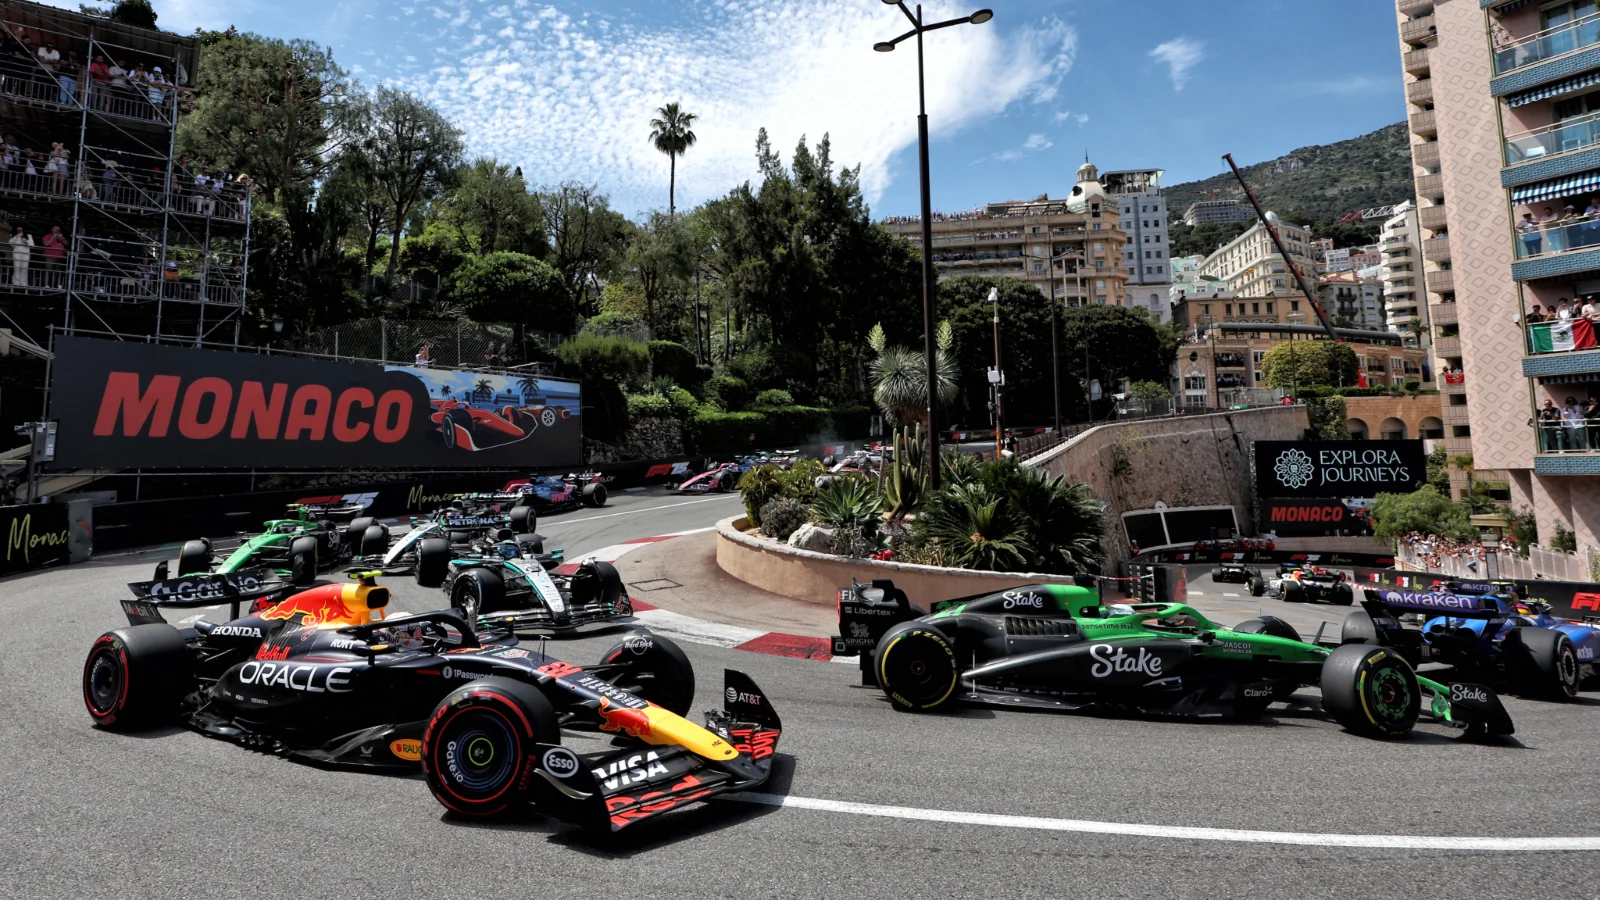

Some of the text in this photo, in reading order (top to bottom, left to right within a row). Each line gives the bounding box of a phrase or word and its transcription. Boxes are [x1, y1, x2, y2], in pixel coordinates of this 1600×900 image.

[94, 371, 413, 443] MONACO
[1319, 450, 1402, 464] EXPLORA
[1319, 467, 1410, 486] JOURNEYS
[1271, 506, 1343, 521] MONACO
[7, 513, 70, 563] Monac
[1472, 583, 1513, 592] krakn
[1002, 591, 1043, 609] Stake
[1403, 592, 1472, 609] kraken
[854, 607, 891, 616] Libertex
[211, 626, 263, 638] HONDA
[845, 637, 875, 645] SINGHA
[1089, 643, 1163, 678] Stake
[239, 661, 354, 693] ORACLE
[738, 692, 761, 706] AT&T
[1244, 687, 1269, 697] Claro
[1451, 684, 1488, 702] Stake
[446, 741, 464, 783] Gate.io
[591, 750, 669, 790] VISA
